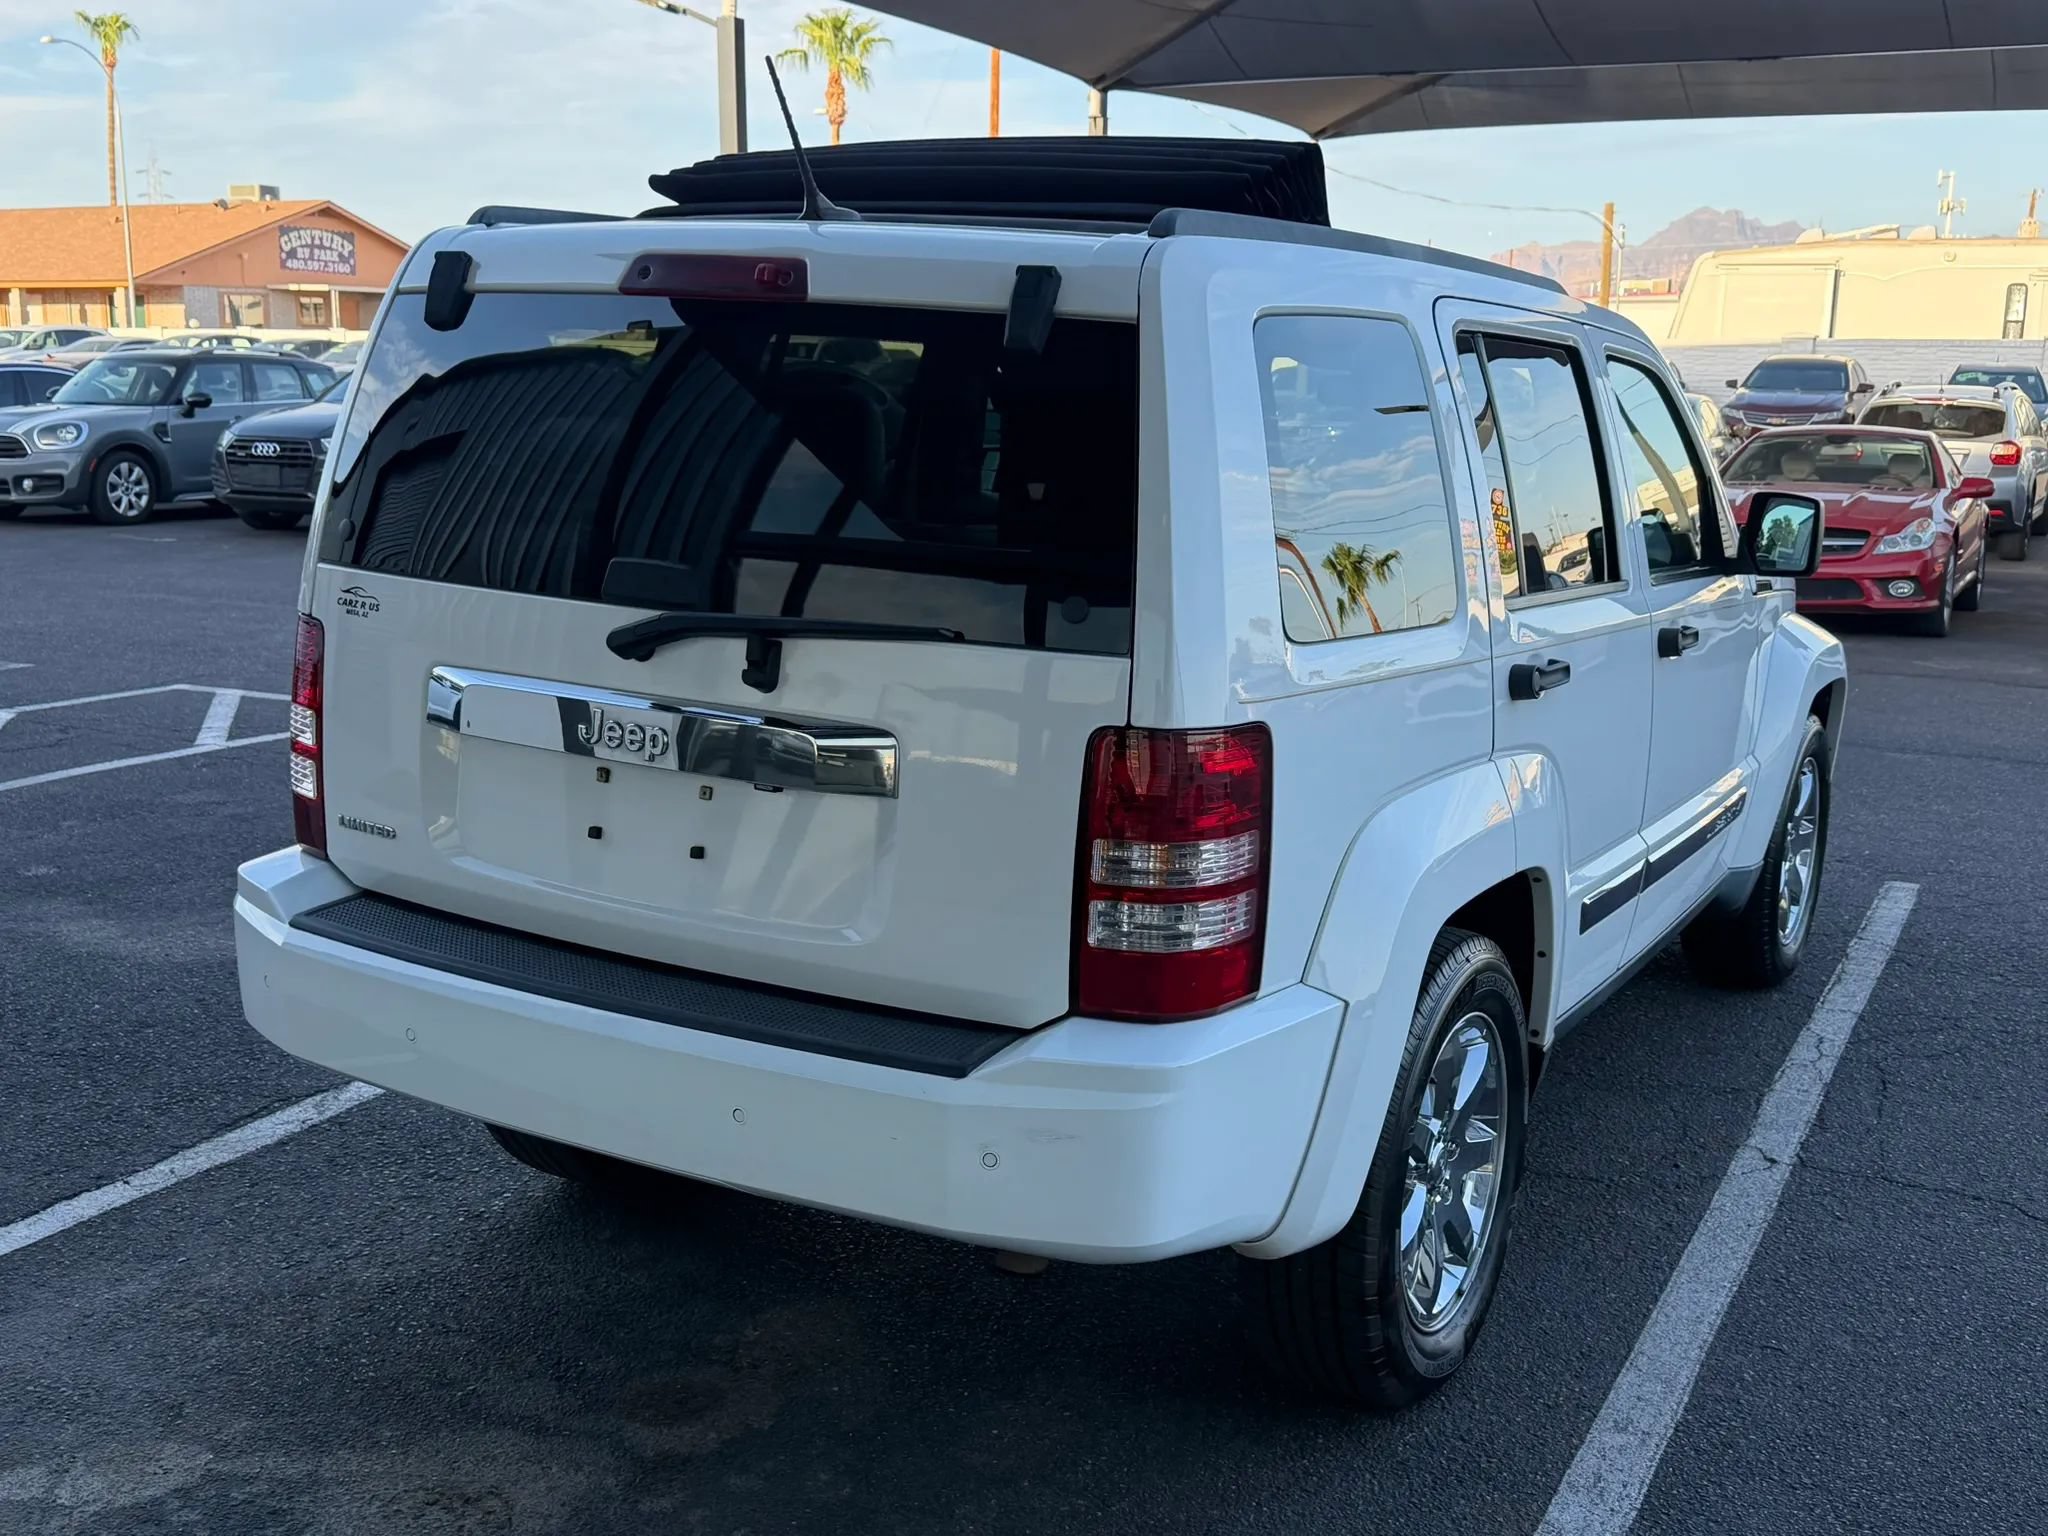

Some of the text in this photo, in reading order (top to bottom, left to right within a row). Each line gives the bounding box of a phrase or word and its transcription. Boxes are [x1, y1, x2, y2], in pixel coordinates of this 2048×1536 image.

[280, 229, 354, 257] CENTURY
[296, 247, 340, 262] RV PARK
[337, 597, 380, 612] CARZ R US
[578, 708, 669, 762] Jeep
[338, 814, 396, 839] LIMITED
